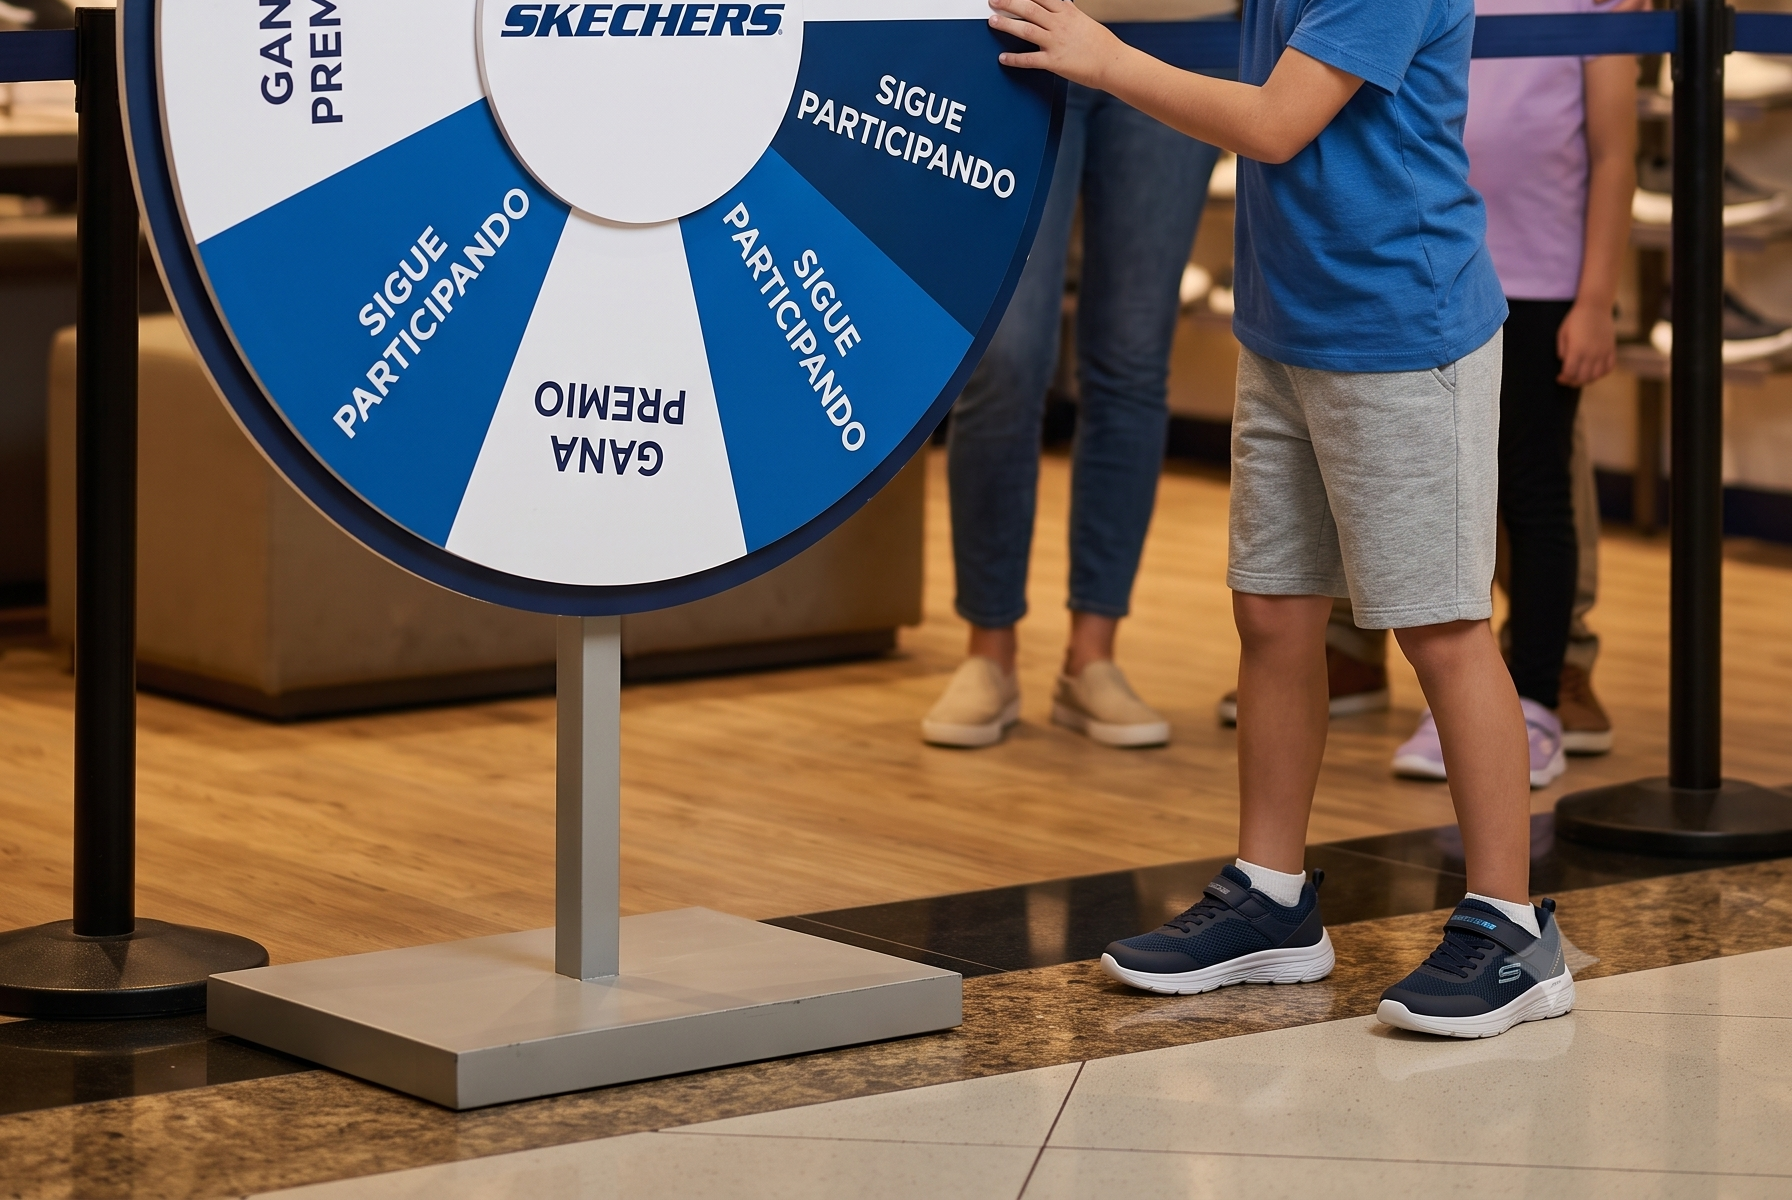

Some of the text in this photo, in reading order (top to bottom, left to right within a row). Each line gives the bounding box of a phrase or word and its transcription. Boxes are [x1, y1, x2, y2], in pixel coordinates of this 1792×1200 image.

[500, 3, 786, 38] SKECHERS
[797, 89, 1016, 199] PARTICIPANDO
[875, 74, 967, 134] SIGUE
[332, 188, 530, 439] PARTICIPANDO
[358, 225, 449, 337] SIGUE
[722, 201, 866, 452] PARTICIPANDO
[793, 249, 862, 358] SIGUE
[534, 380, 687, 426] PREMIO
[550, 435, 664, 477] GANA
